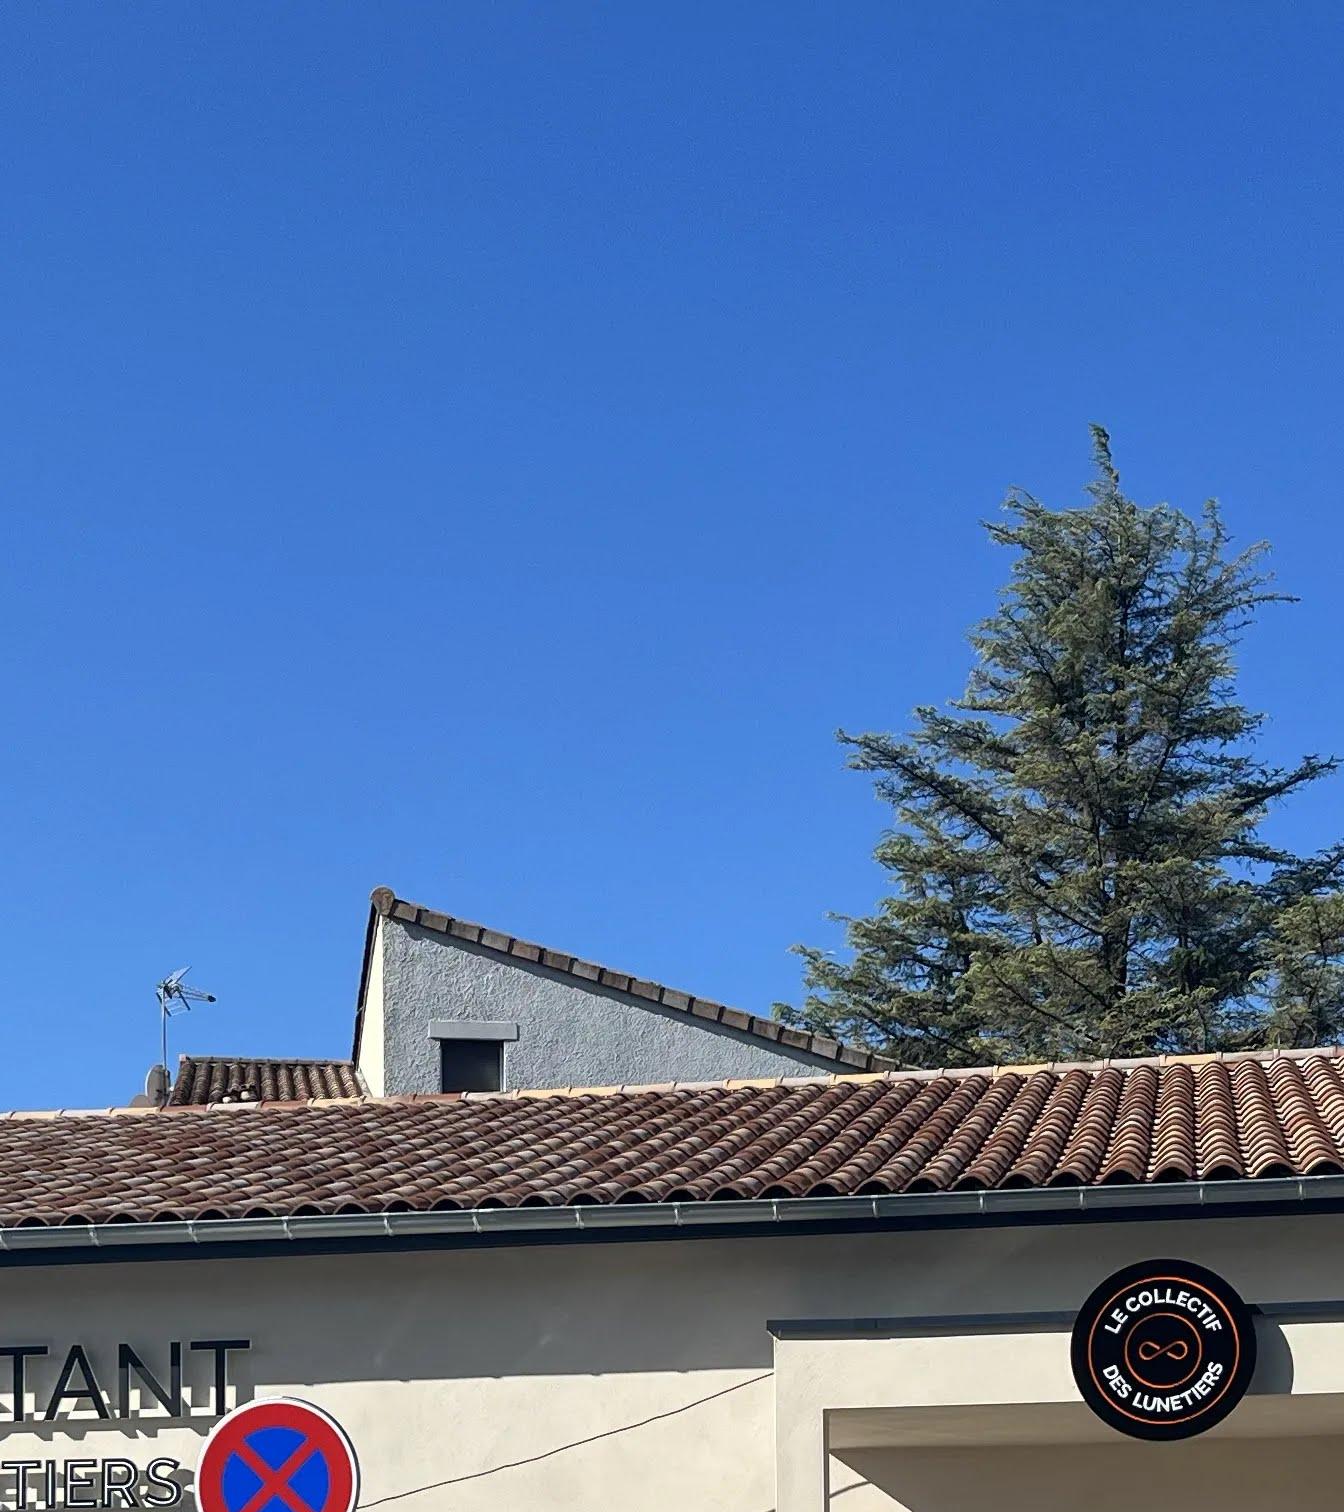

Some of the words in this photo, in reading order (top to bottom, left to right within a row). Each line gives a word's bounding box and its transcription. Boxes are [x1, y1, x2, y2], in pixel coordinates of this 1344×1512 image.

[1104, 1308, 1128, 1334] LE
[1125, 1288, 1222, 1332] COLLECTIF
[1102, 1364, 1132, 1398] DES
[1132, 1361, 1223, 1412] LUNETIERS
